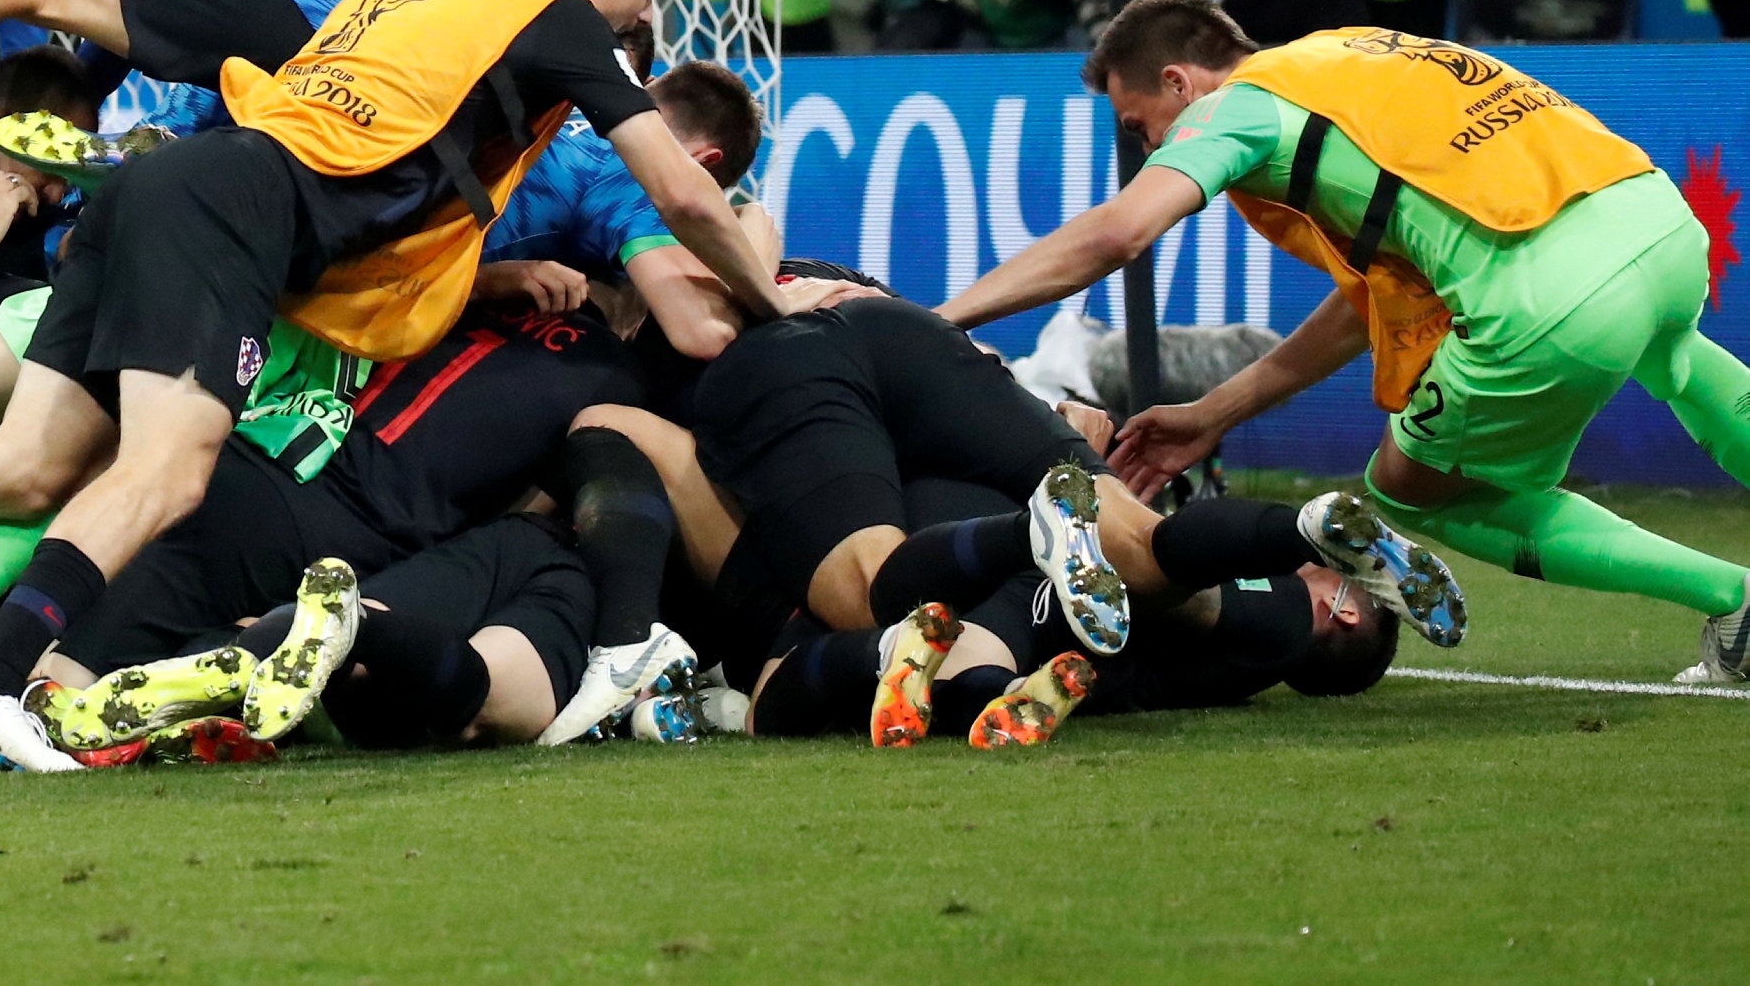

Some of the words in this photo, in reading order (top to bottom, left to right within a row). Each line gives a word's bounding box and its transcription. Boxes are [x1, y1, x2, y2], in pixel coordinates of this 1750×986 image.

[331, 68, 355, 83] CUP
[310, 80, 377, 127] 2018
[1465, 98, 1493, 116] FIFA
[1449, 92, 1547, 154] RUSSIA
